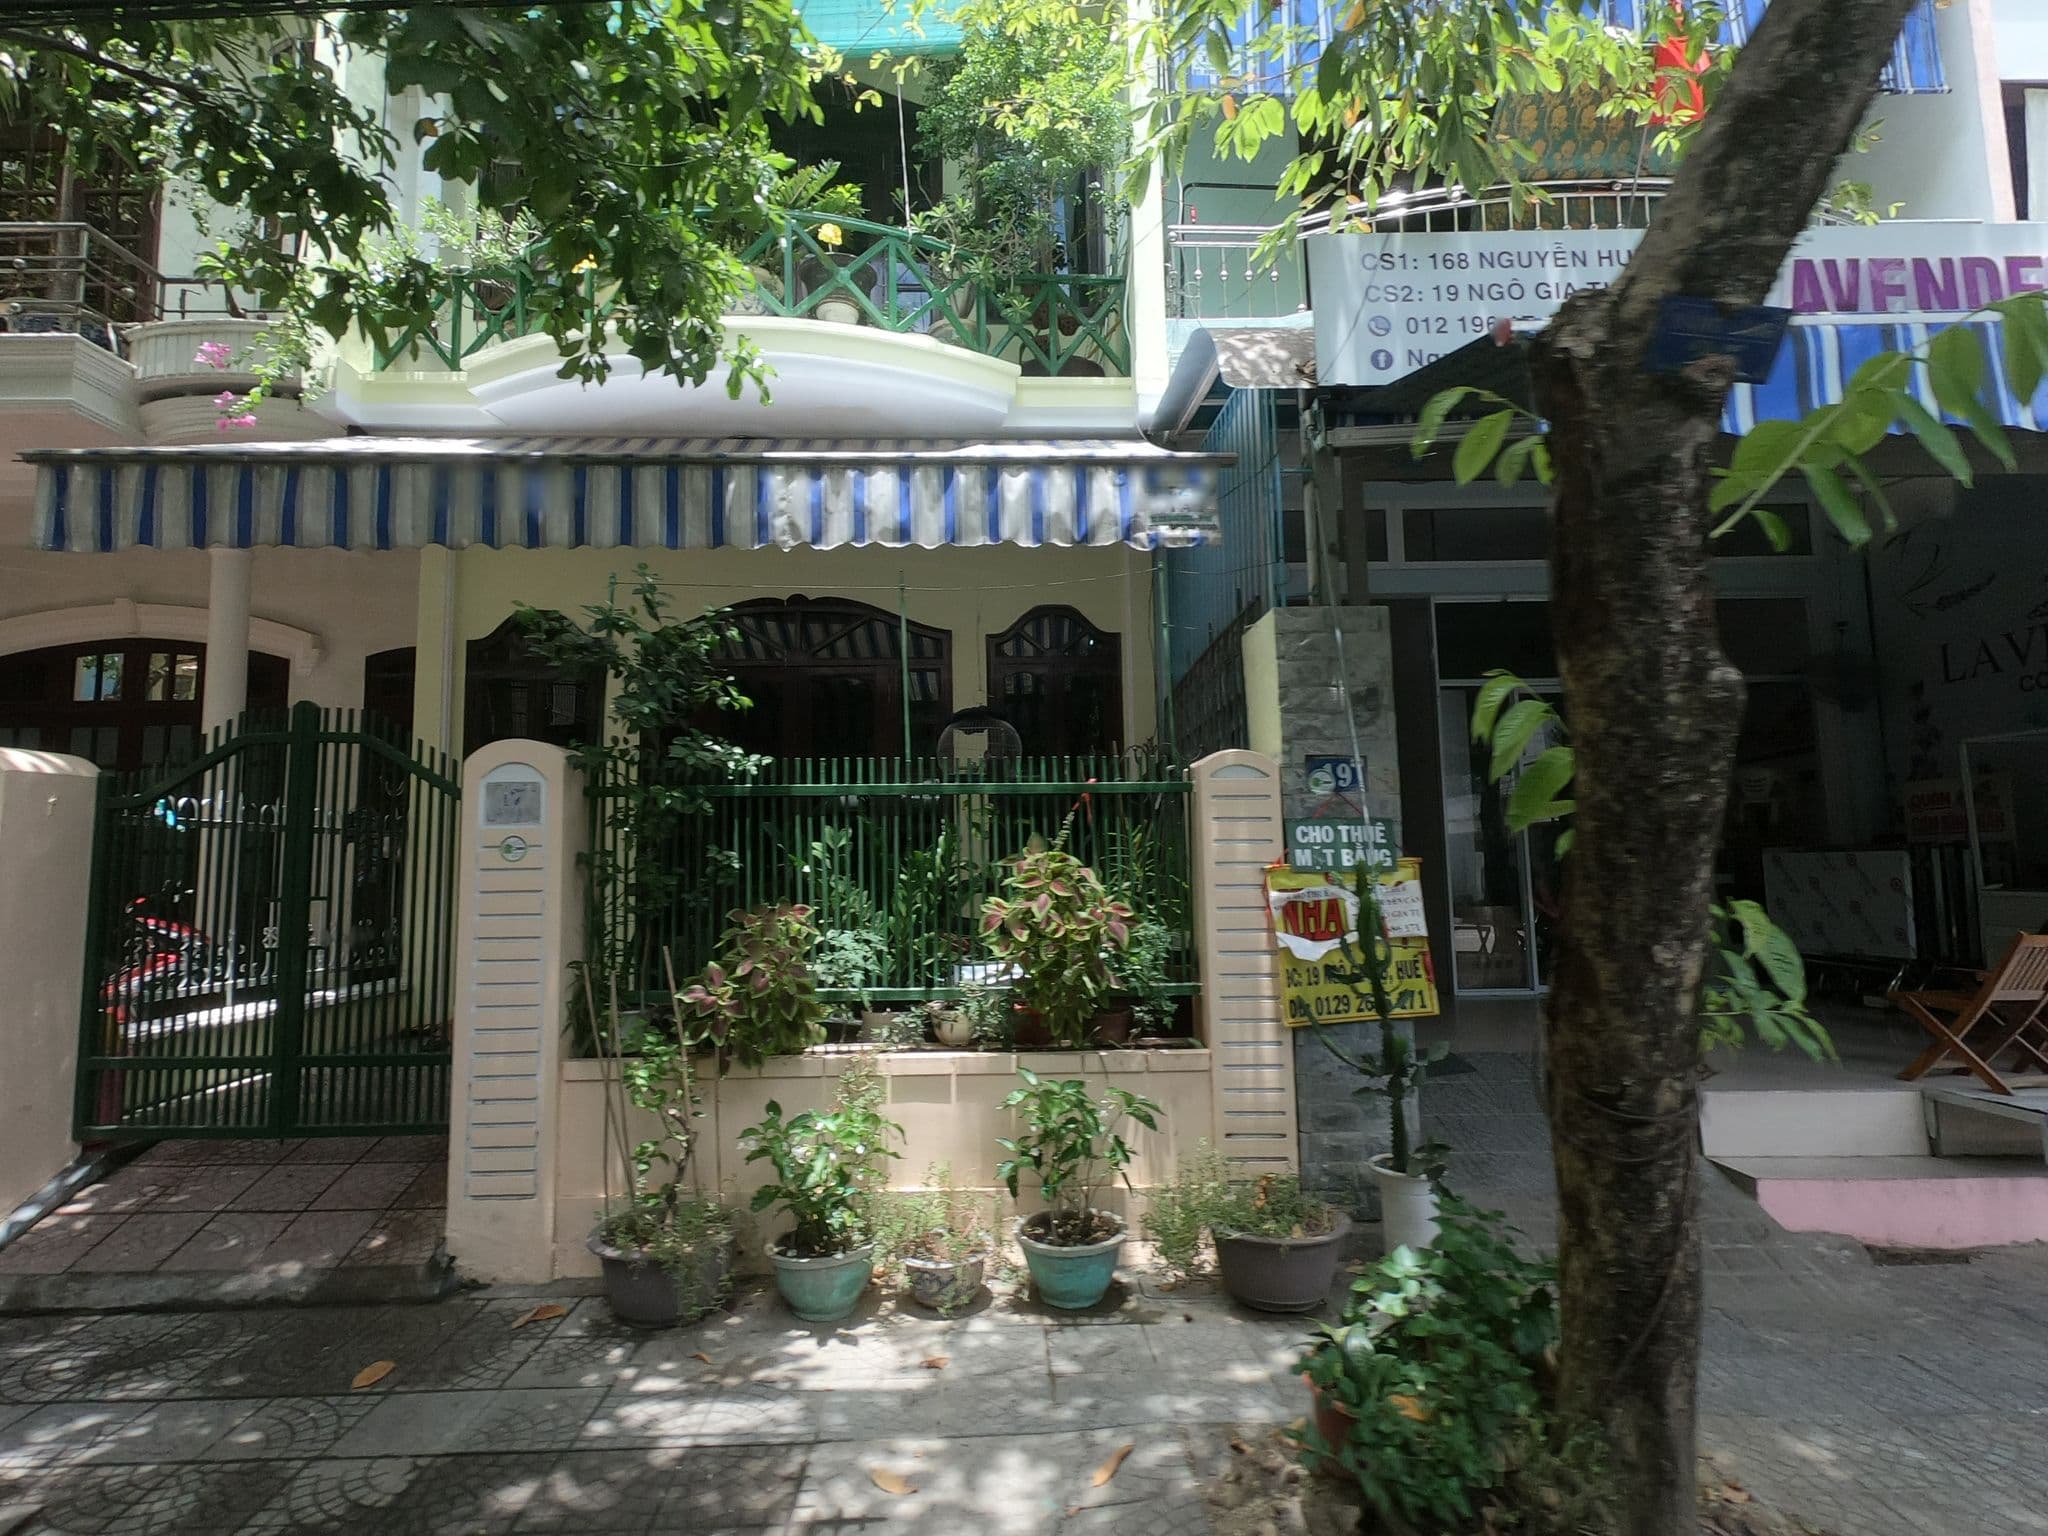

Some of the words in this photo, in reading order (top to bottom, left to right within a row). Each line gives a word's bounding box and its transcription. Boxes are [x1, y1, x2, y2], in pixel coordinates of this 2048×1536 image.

[1361, 252, 1418, 271] CS1:
[1428, 252, 1469, 270] 168
[1479, 241, 1587, 269] NGUYỄN
[1366, 284, 1423, 303] CS2:
[1432, 284, 1459, 302] 19
[1468, 277, 1525, 301] NGÔ
[1535, 282, 1577, 300] GIA
[1406, 316, 1448, 335] 012
[1295, 824, 1335, 844] CHO
[1336, 821, 1388, 844] THUÊ
[1306, 965, 1321, 986] 19
[1315, 994, 1351, 1017] 0129
